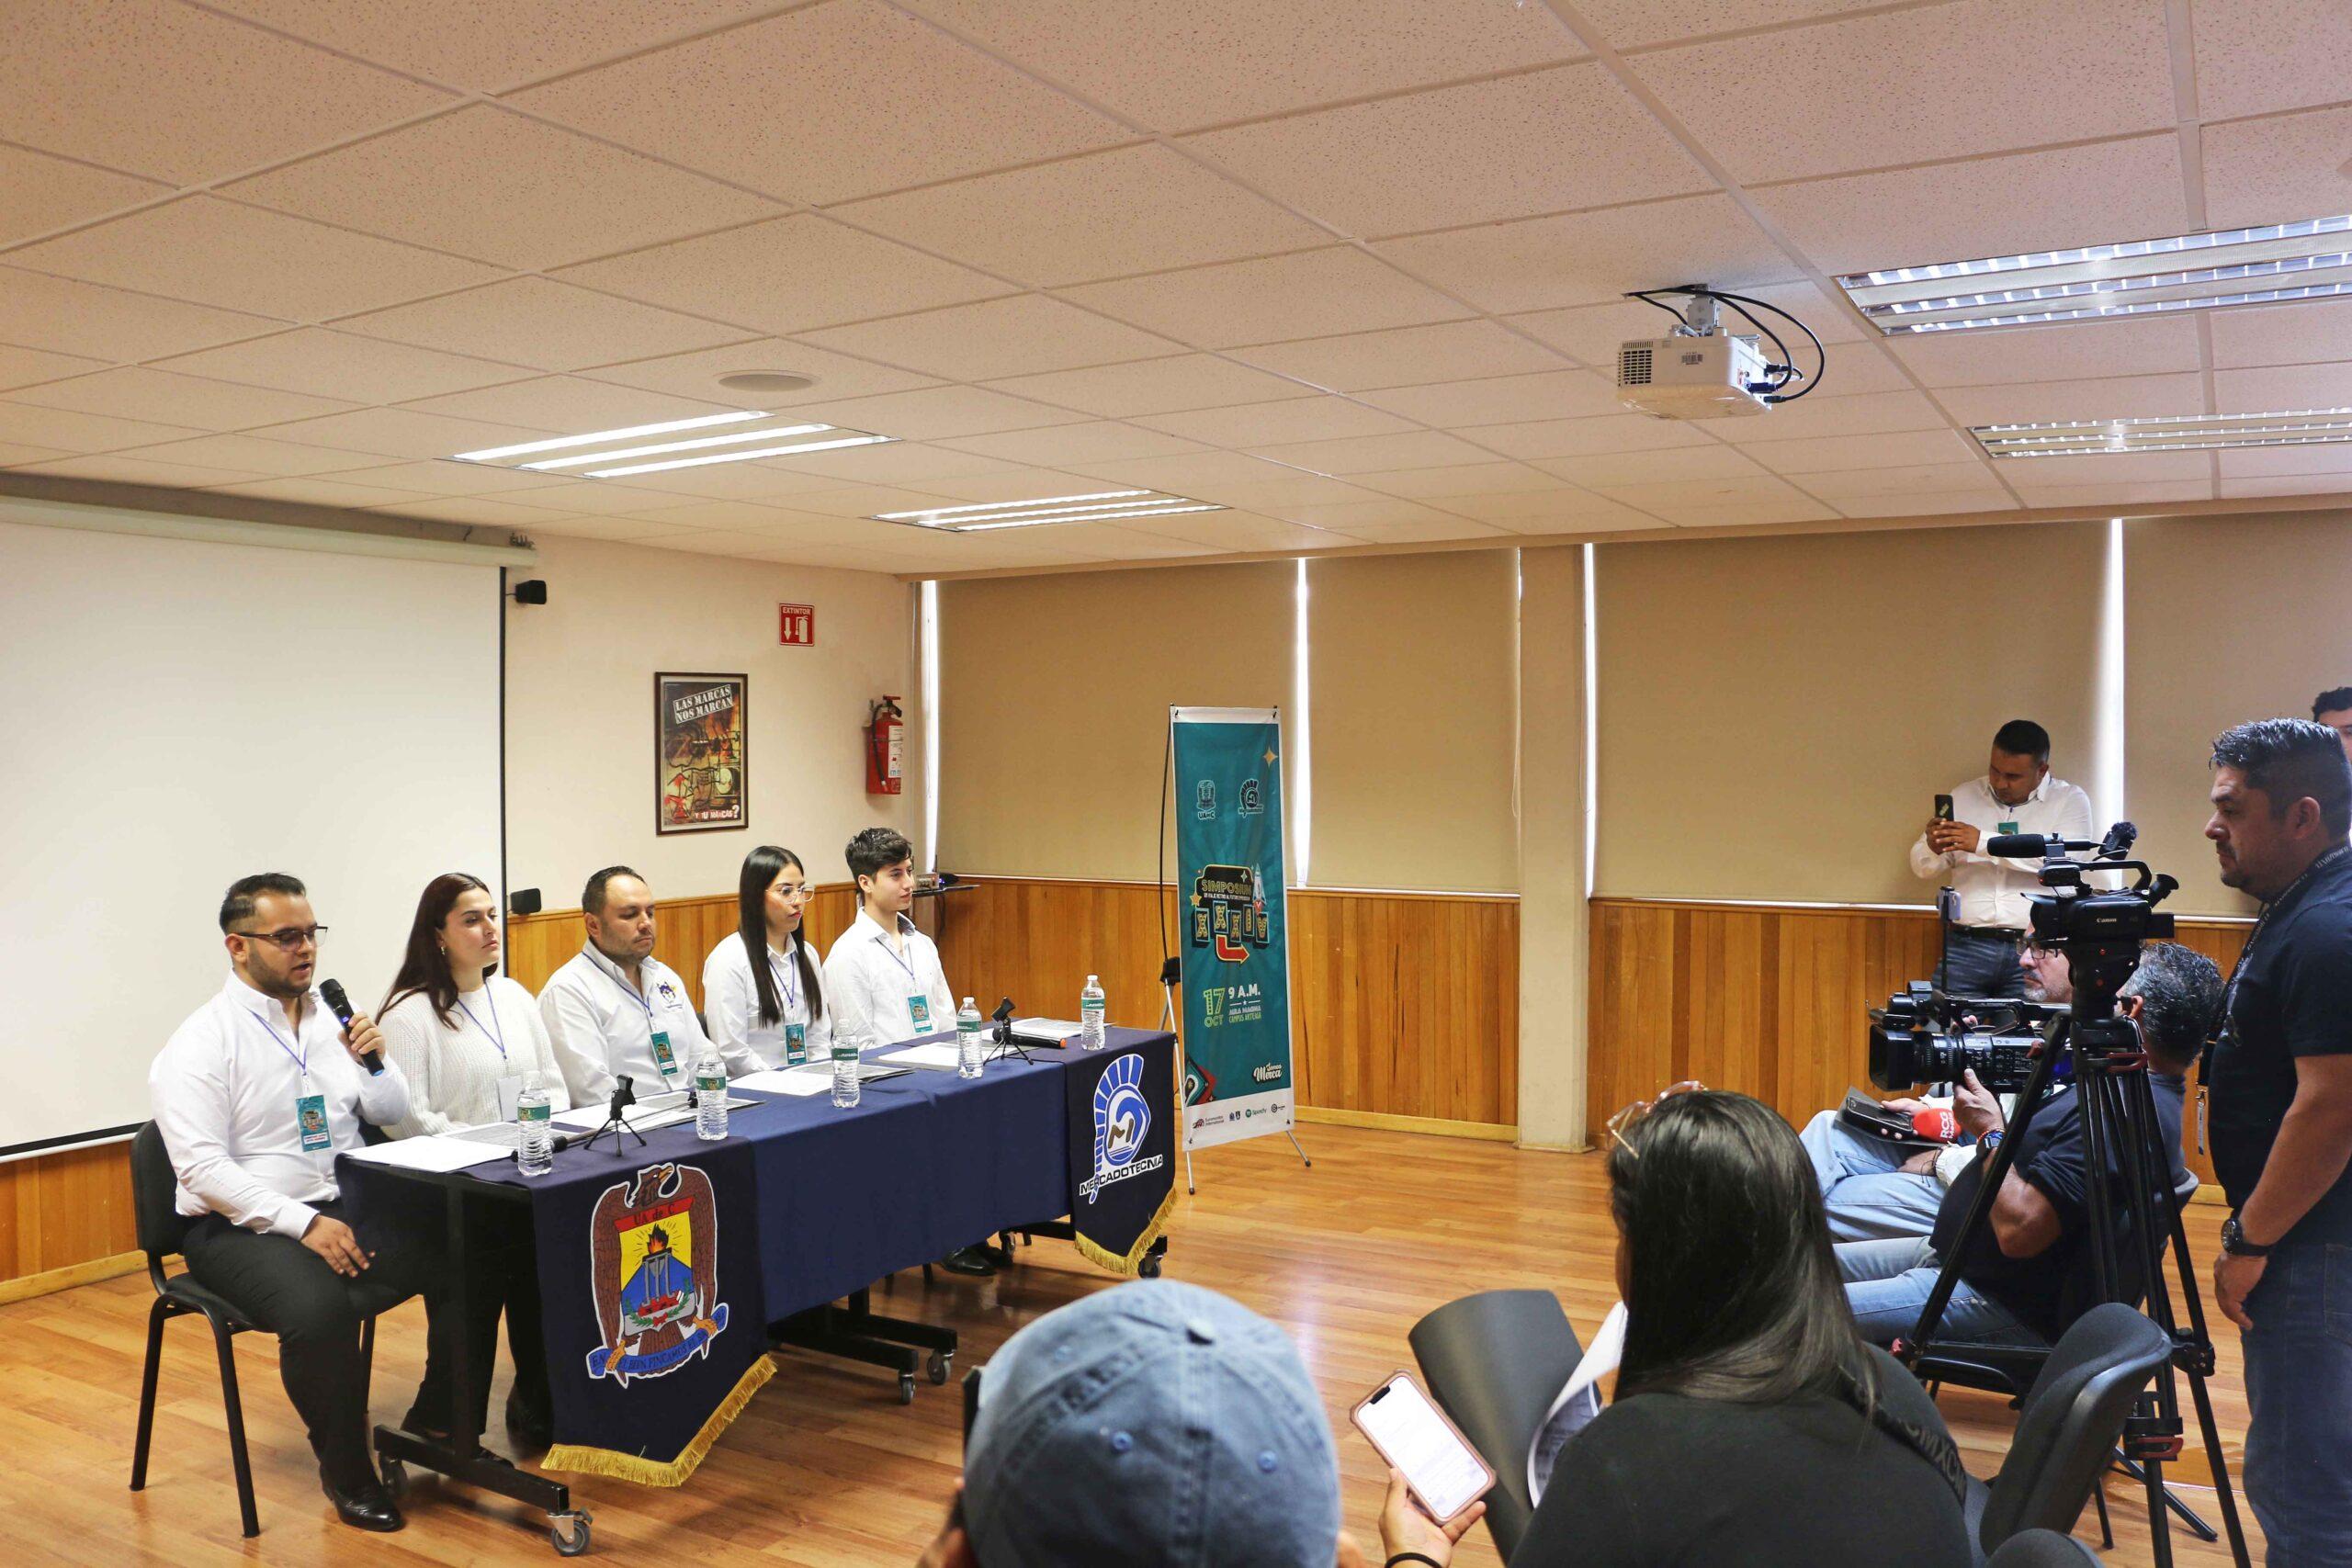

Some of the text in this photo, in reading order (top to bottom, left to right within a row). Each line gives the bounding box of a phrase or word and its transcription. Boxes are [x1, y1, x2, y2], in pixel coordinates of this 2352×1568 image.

[783, 606, 811, 615] EXTINTOR
[675, 686, 731, 712] LAS MARCAS
[676, 696, 733, 724] NOS MARCAN
[1204, 987, 1226, 1015] 17
[1228, 983, 1261, 999] 9 A.M.
[1204, 1014, 1224, 1028] OCT
[1253, 1066, 1283, 1082] Merca
[1939, 1112, 1949, 1138] RCG
[1080, 1155, 1163, 1194] MERCADOTECNIA
